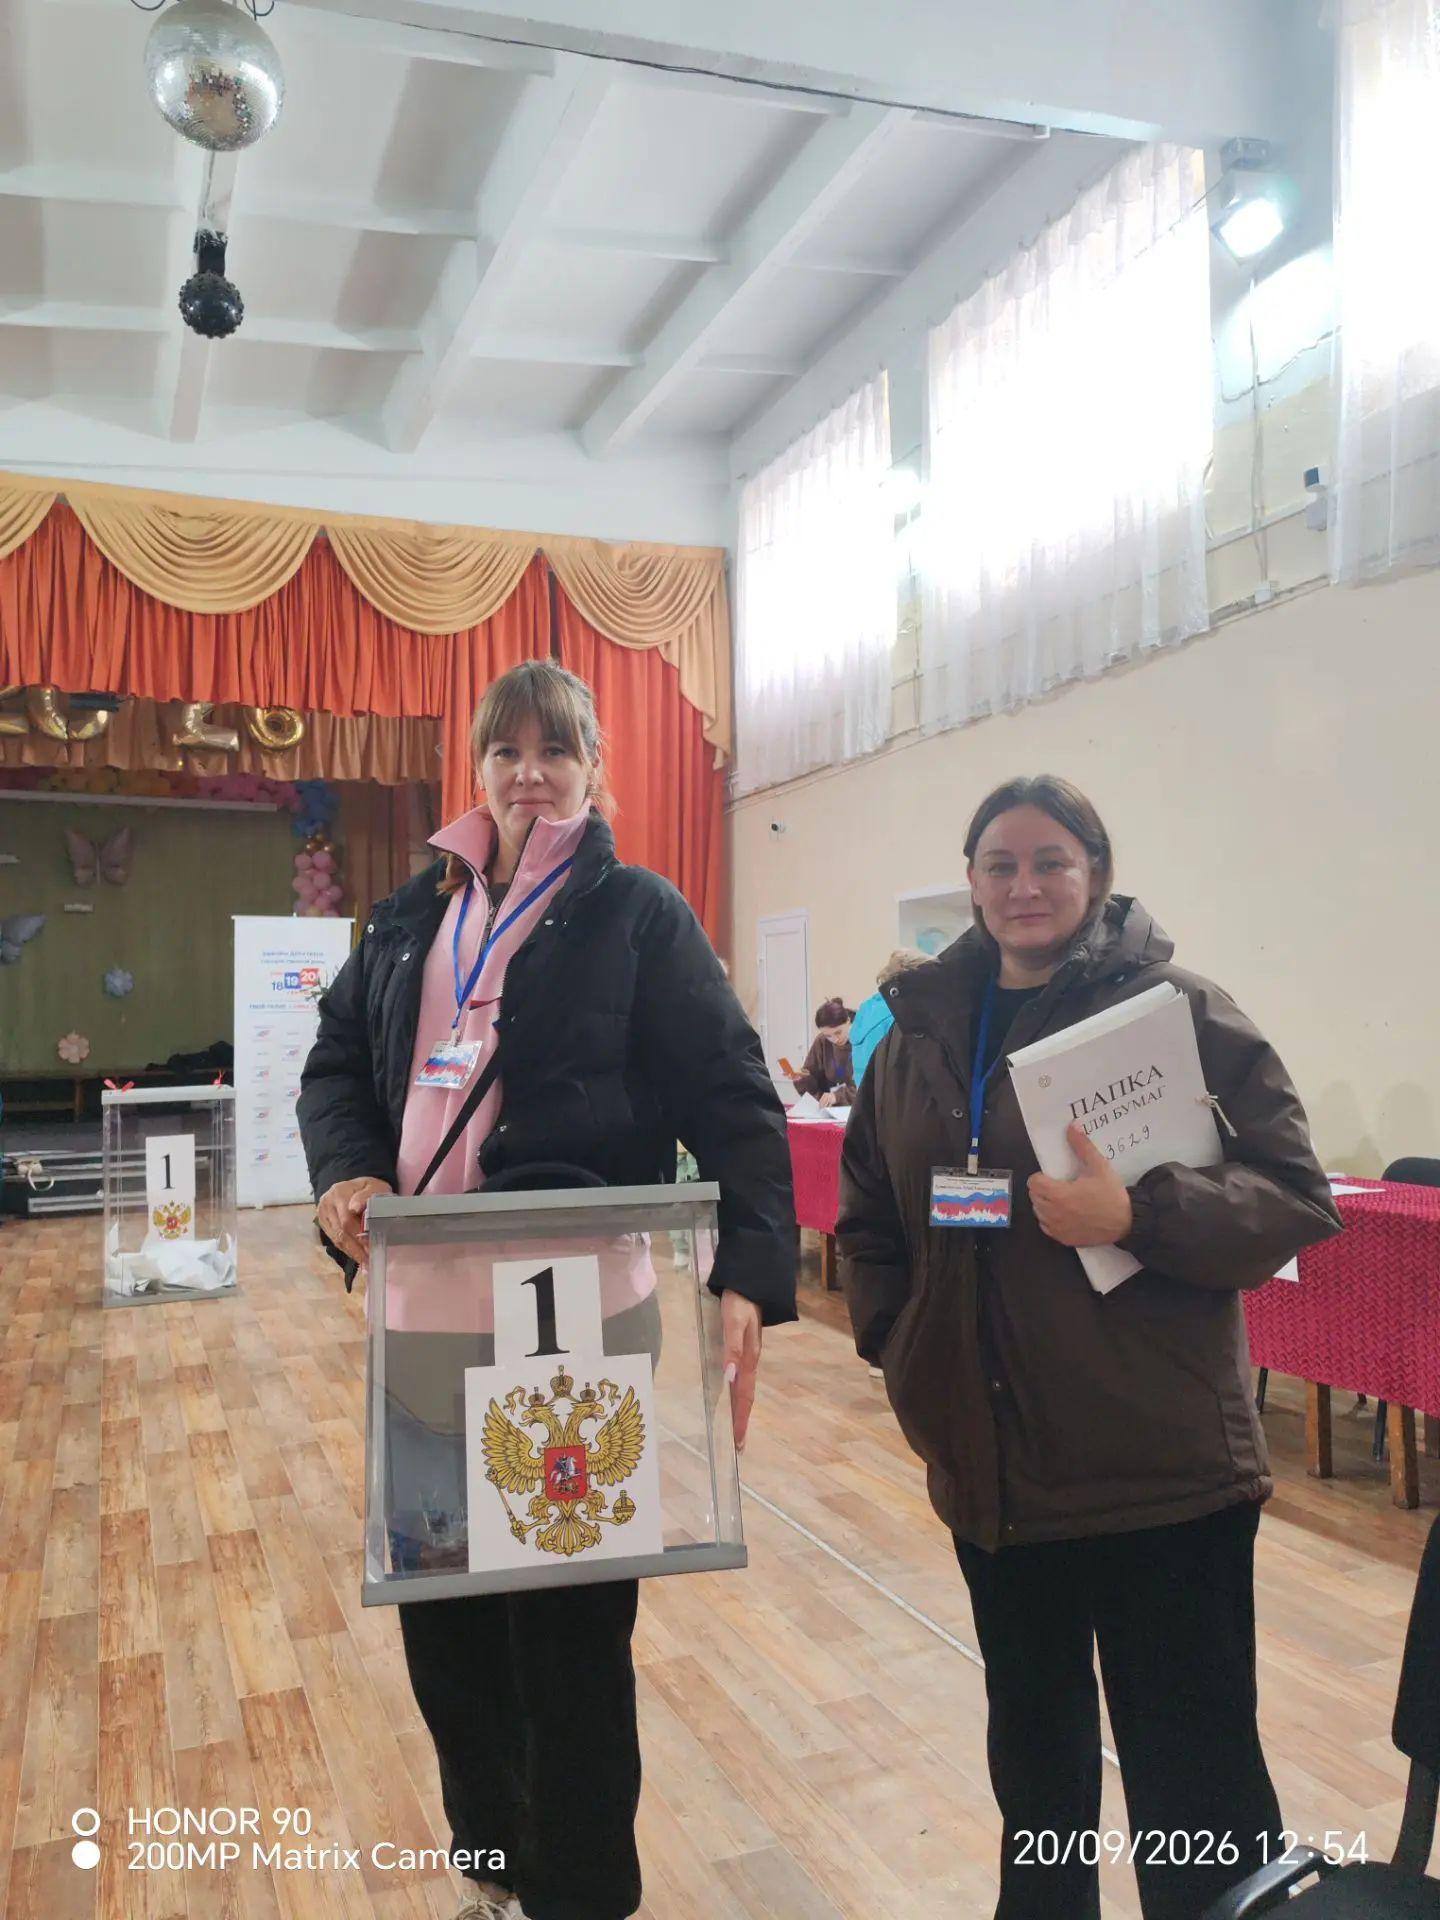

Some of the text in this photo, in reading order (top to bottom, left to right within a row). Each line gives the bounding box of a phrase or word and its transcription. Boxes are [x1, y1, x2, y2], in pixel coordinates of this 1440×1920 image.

[1069, 1065, 1163, 1119] ПАПКА
[1113, 1085, 1166, 1120] БУМАГ
[1105, 1125, 1151, 1160] 3629
[161, 1153, 176, 1190] 1
[520, 1266, 570, 1357] 1
